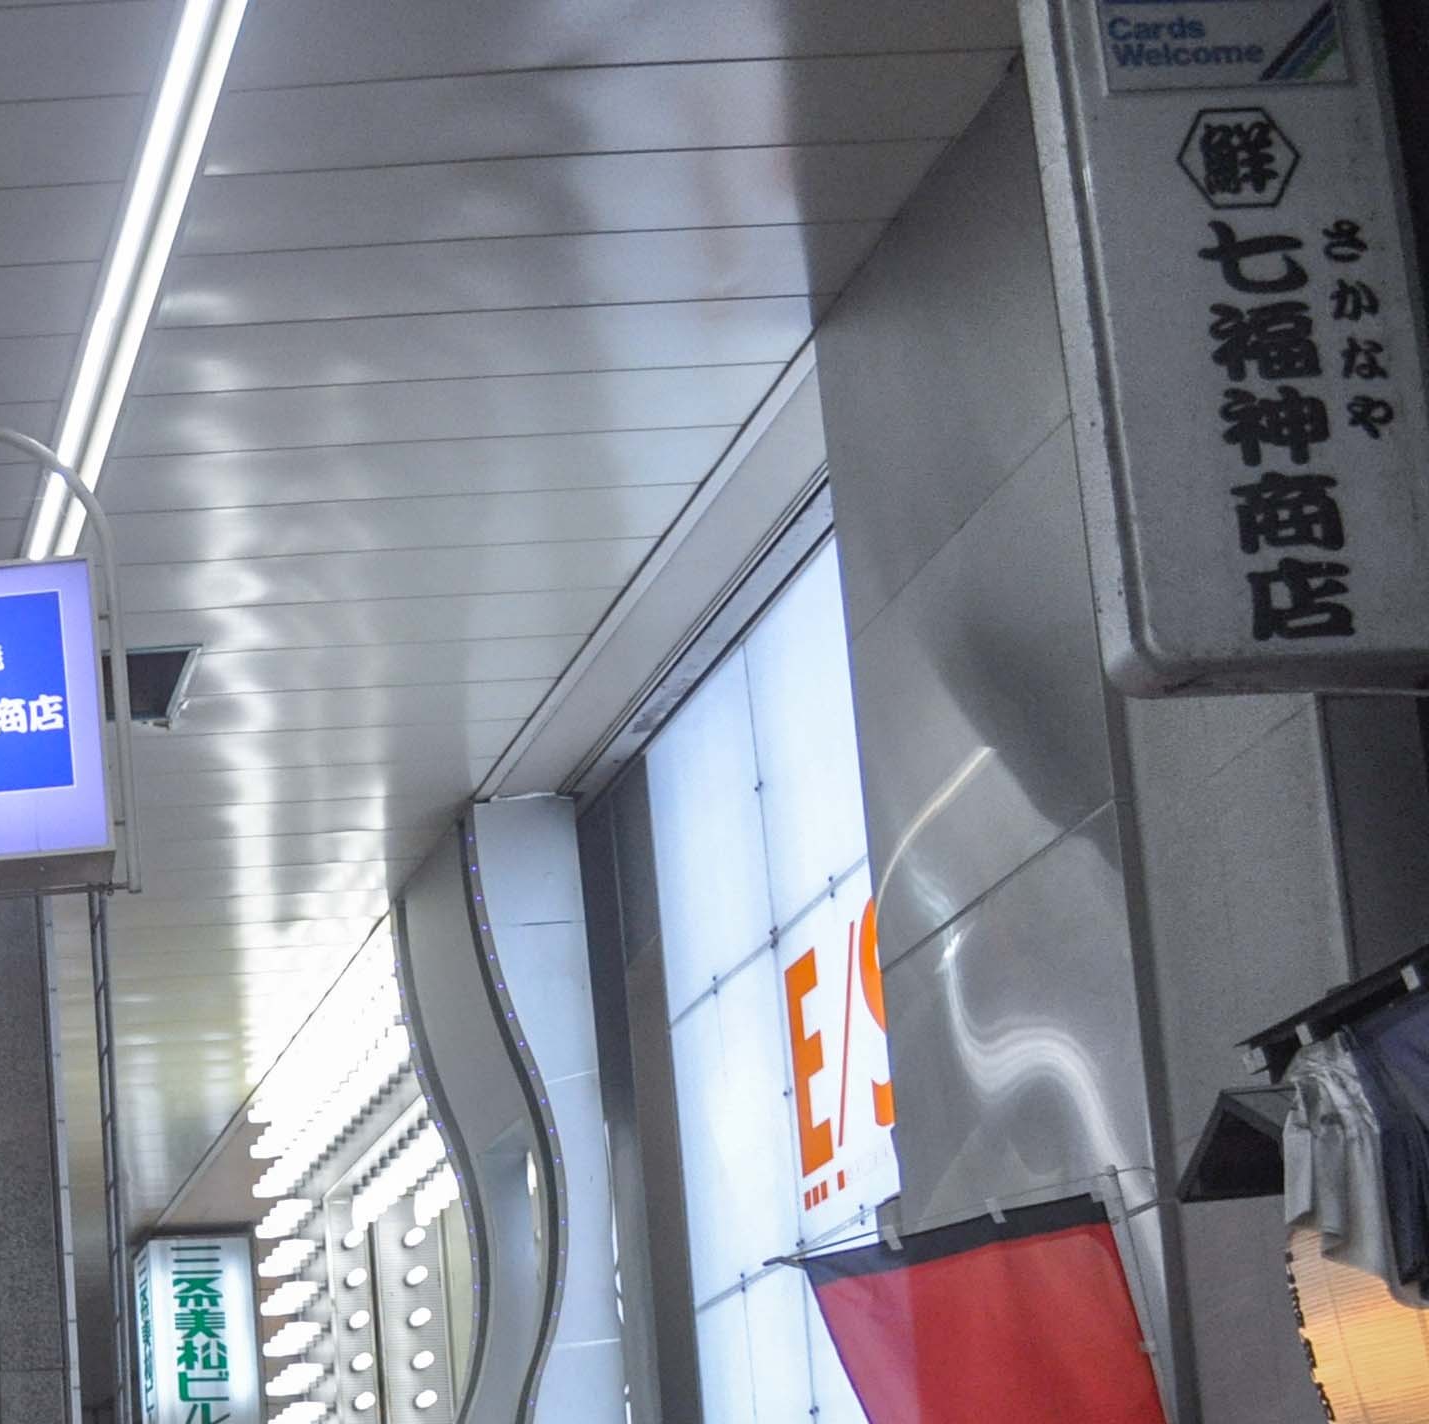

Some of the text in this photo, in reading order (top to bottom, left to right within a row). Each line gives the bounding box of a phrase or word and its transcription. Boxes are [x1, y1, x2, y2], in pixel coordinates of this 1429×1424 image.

[1108, 17, 1205, 41] Cards
[1113, 43, 1265, 66] Welcome
[1322, 219, 1394, 439] さかなや
[1197, 220, 1355, 641] 七福神商店
